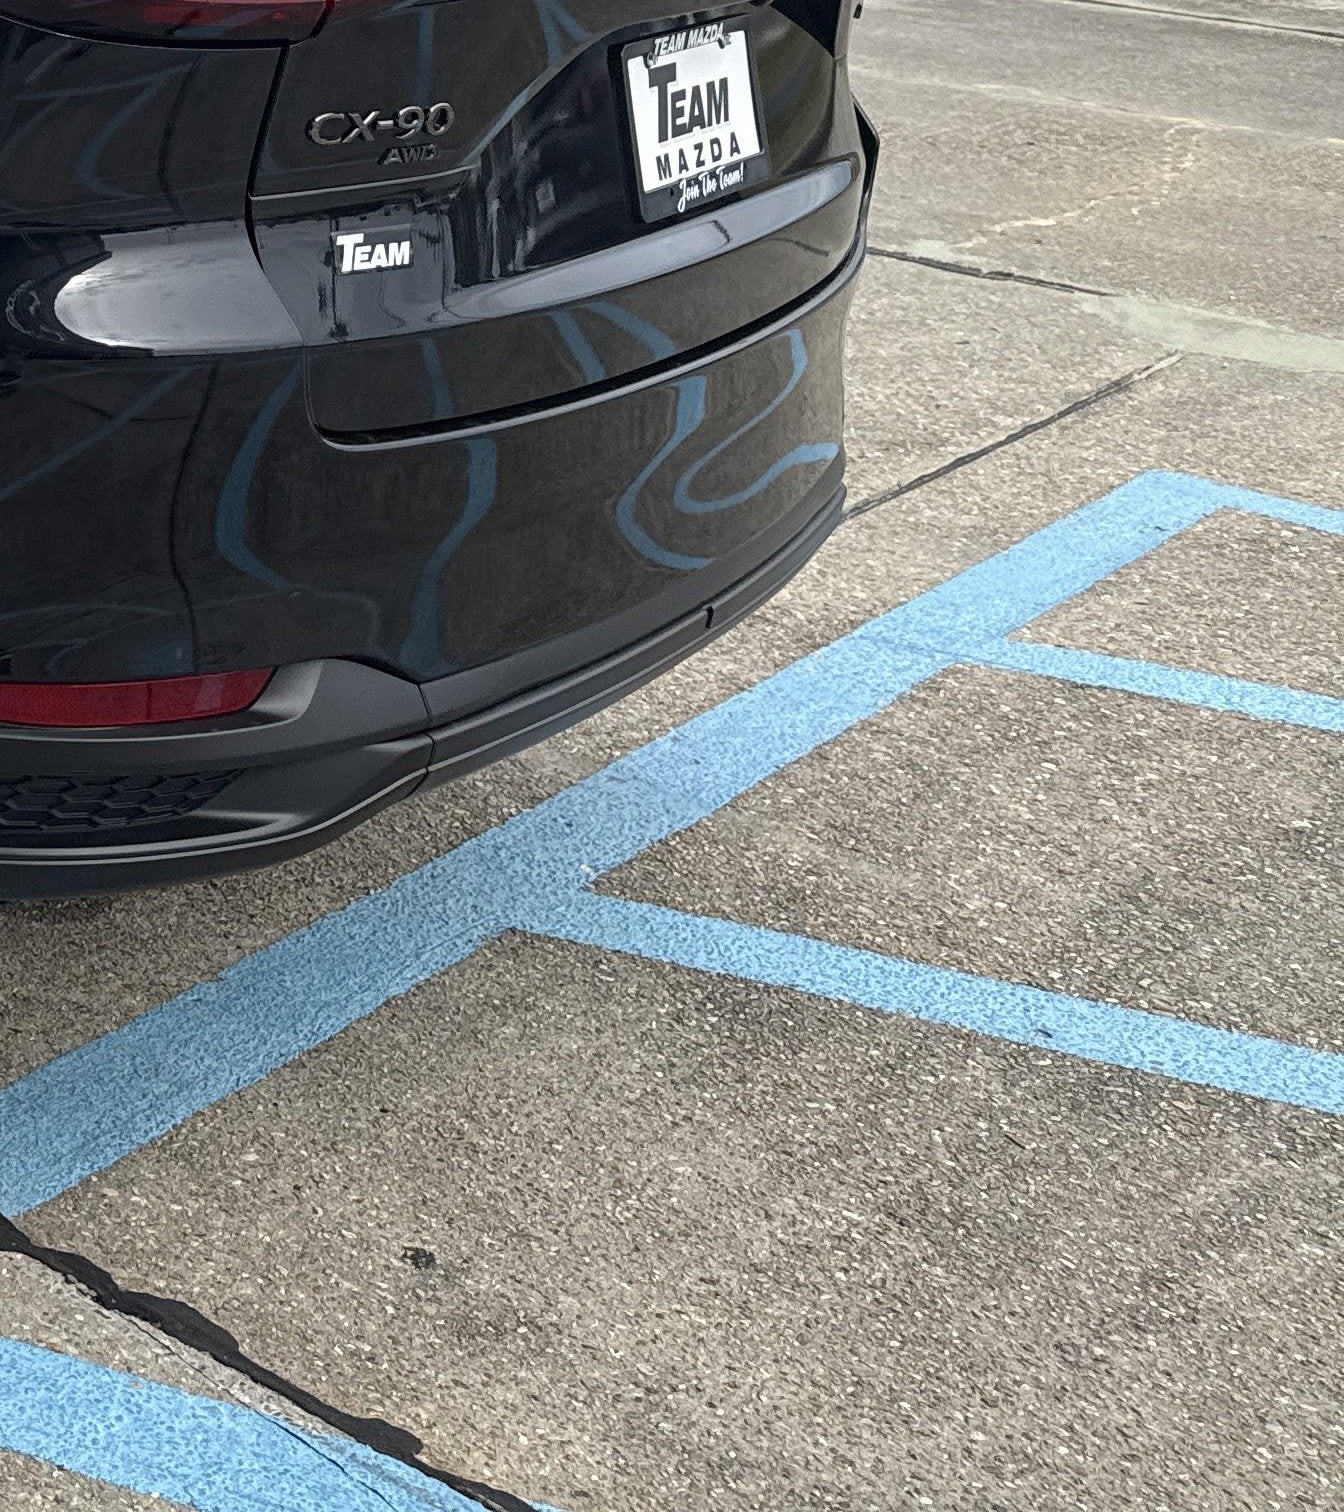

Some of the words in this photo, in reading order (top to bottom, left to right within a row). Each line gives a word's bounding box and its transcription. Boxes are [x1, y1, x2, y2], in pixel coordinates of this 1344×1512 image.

[654, 32, 687, 55] TEAM
[687, 22, 724, 49] MAZDA
[307, 102, 456, 145] CX-90
[648, 62, 729, 143] TEAM
[381, 143, 439, 165] AWD
[656, 131, 741, 181] MAZDA
[677, 178, 699, 213] Join
[698, 171, 717, 197] The
[336, 232, 410, 274] TEAM
